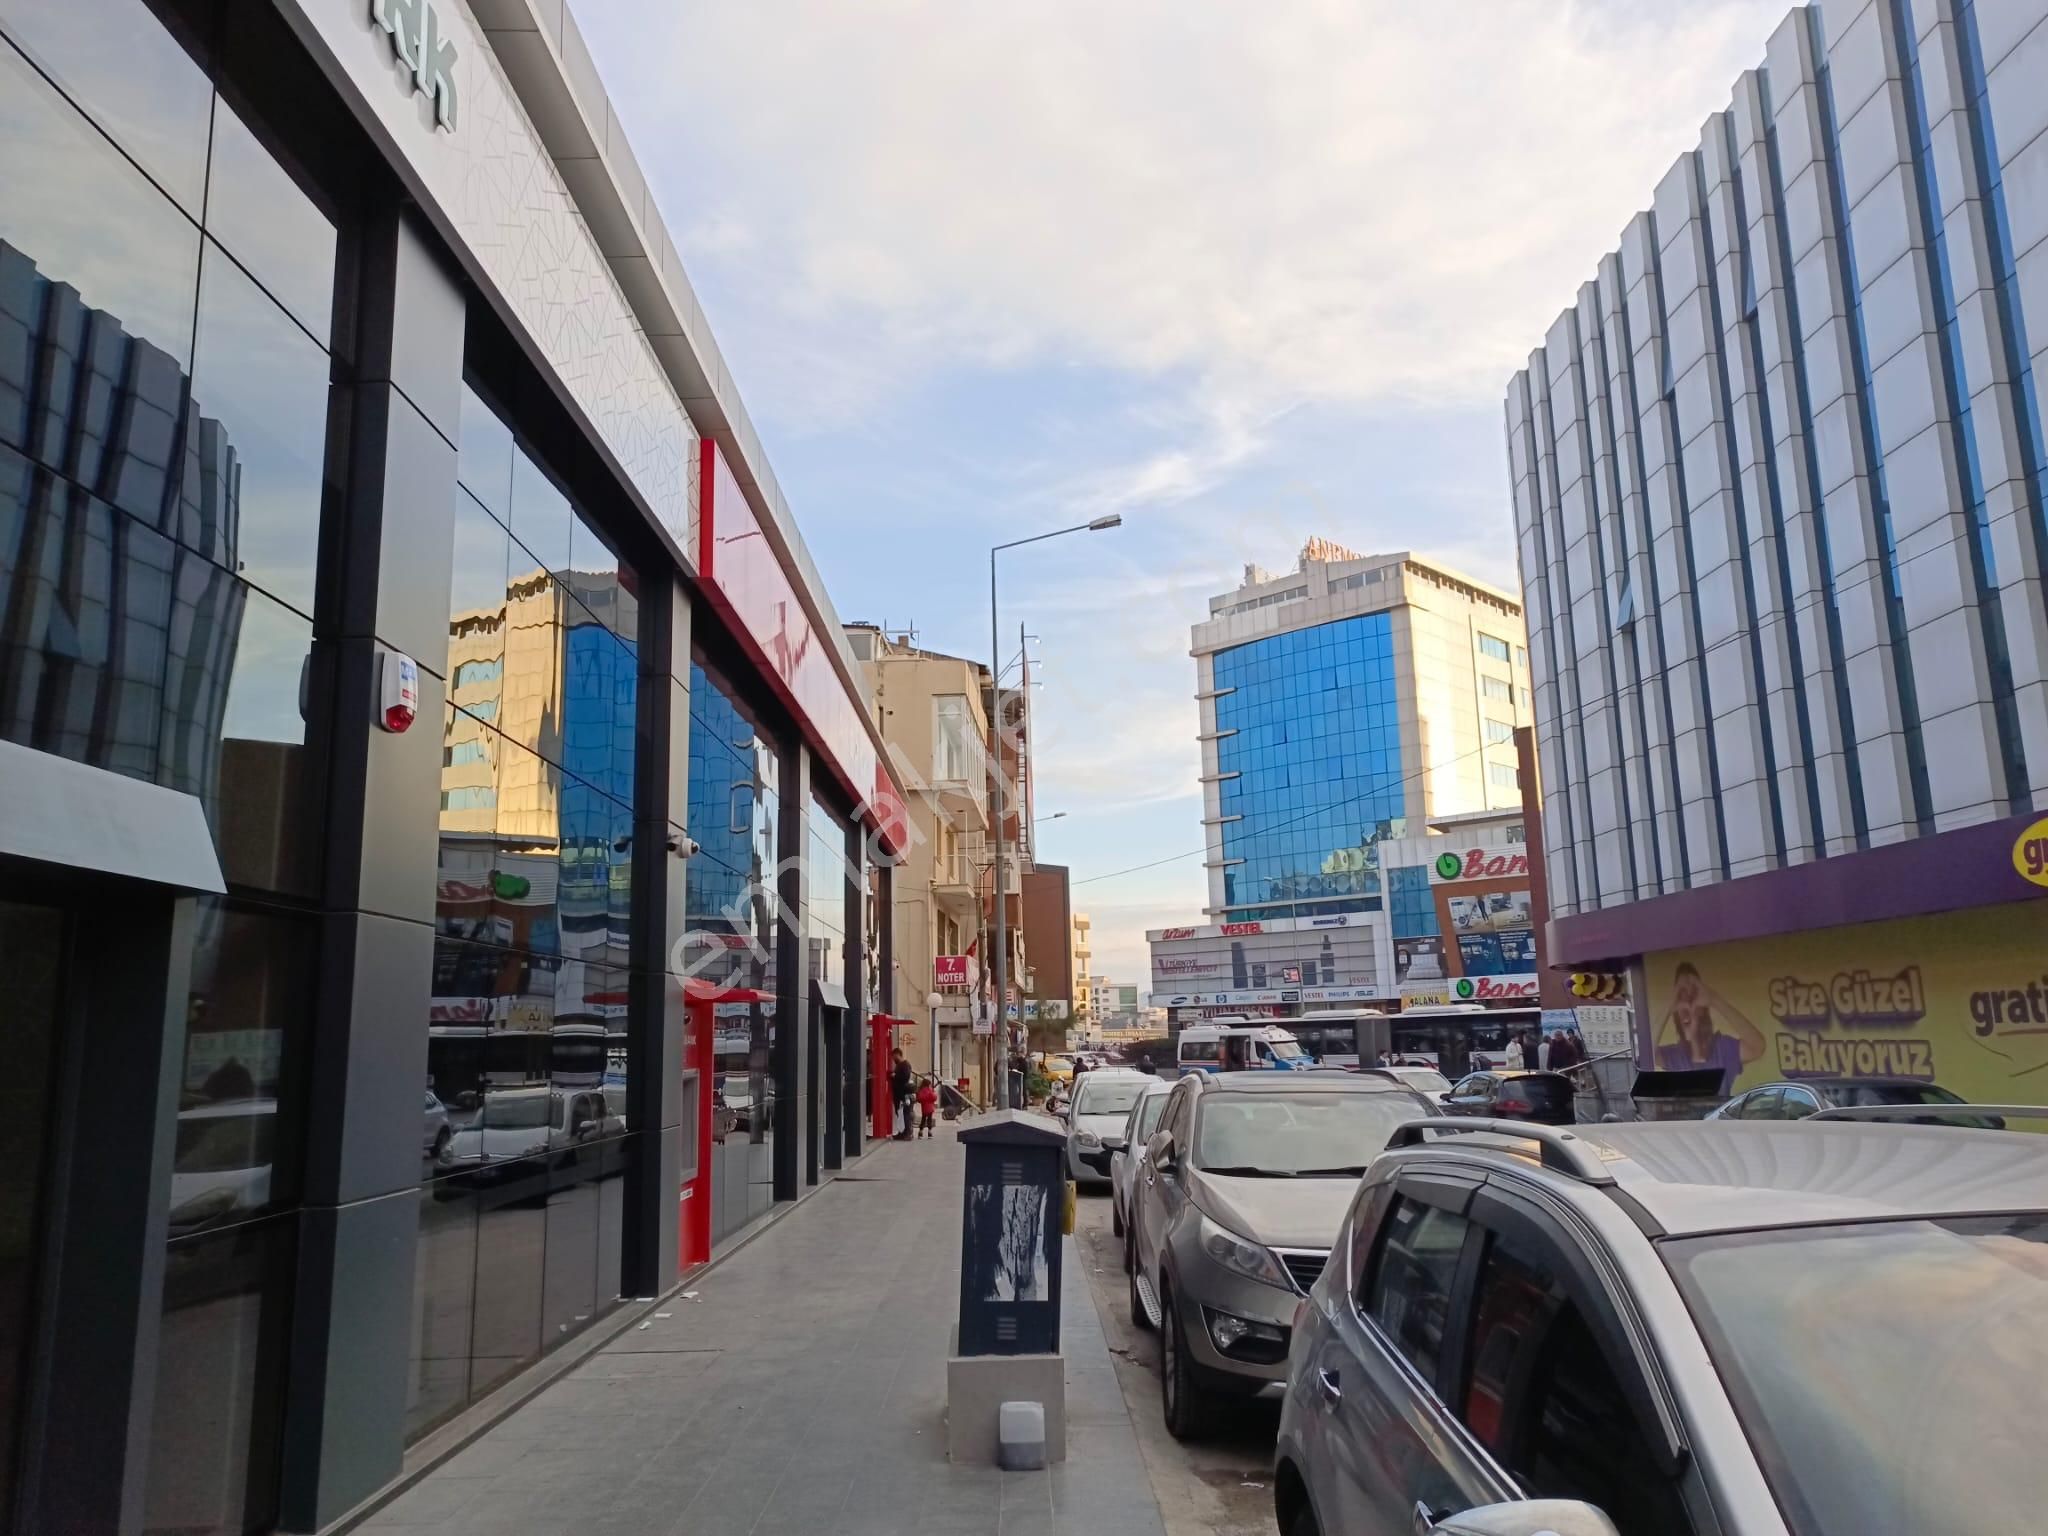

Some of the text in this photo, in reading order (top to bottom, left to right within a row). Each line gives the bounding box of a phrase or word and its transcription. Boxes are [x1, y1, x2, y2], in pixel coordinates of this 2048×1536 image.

[1162, 928, 1196, 940] arzum
[1220, 922, 1264, 936] VESTEL
[946, 958, 956, 971] 7.
[937, 972, 965, 983] NOTER
[1769, 966, 1925, 1019] Size Güzel
[1776, 1031, 1935, 1081] Bakıyoruz
